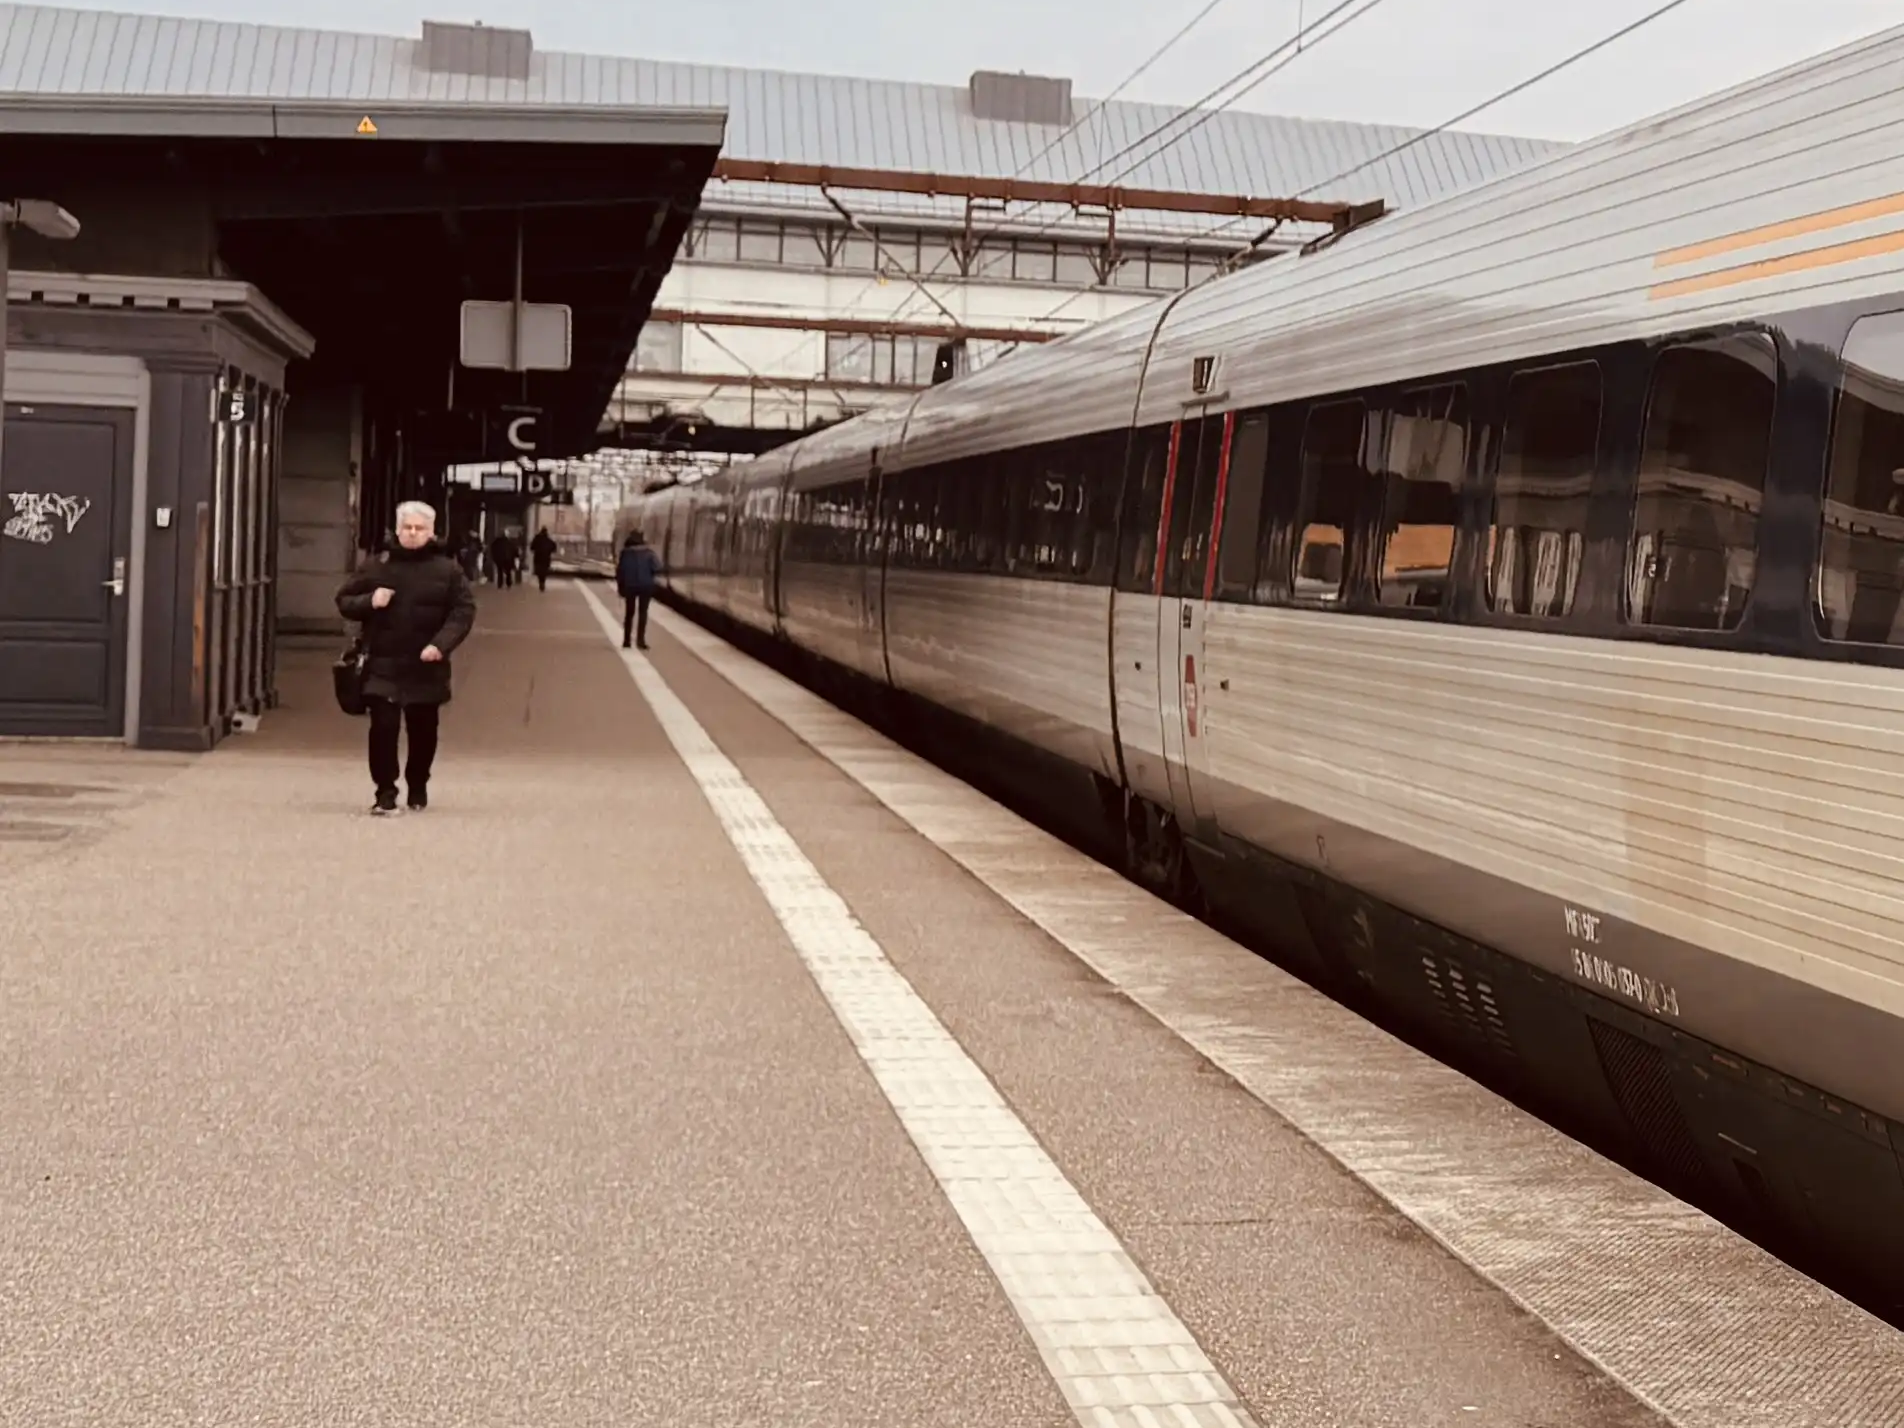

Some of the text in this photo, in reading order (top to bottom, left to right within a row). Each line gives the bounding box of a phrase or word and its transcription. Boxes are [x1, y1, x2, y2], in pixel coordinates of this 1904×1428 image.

[230, 401, 245, 421] 5
[507, 416, 536, 450] C
[528, 474, 545, 493] D
